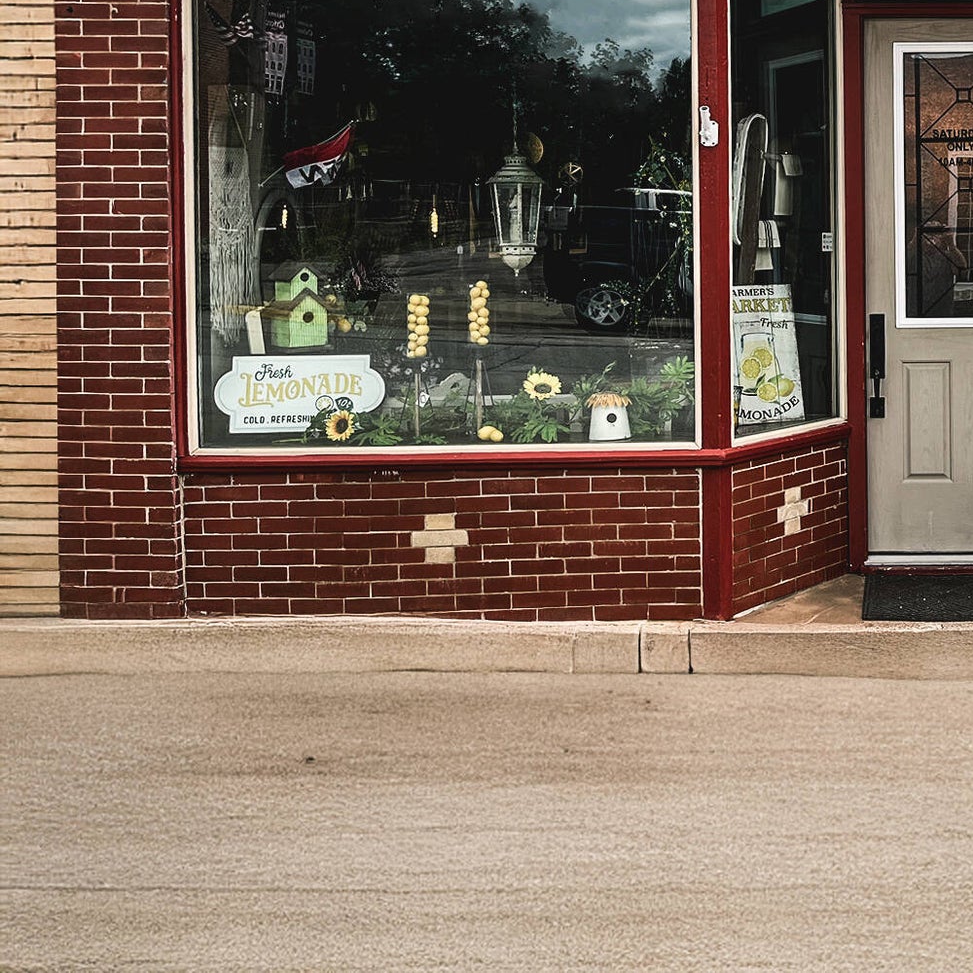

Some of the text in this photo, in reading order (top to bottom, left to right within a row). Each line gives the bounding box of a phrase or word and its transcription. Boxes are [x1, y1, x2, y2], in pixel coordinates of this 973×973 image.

[732, 287, 775, 297] ARMER'S
[732, 297, 791, 314] ARKET
[760, 317, 789, 330] Fresh
[254, 363, 294, 382] Fresh
[238, 372, 363, 408] LEMONADE
[738, 395, 800, 420] MONADE
[270, 414, 315, 423] REFRESHI
